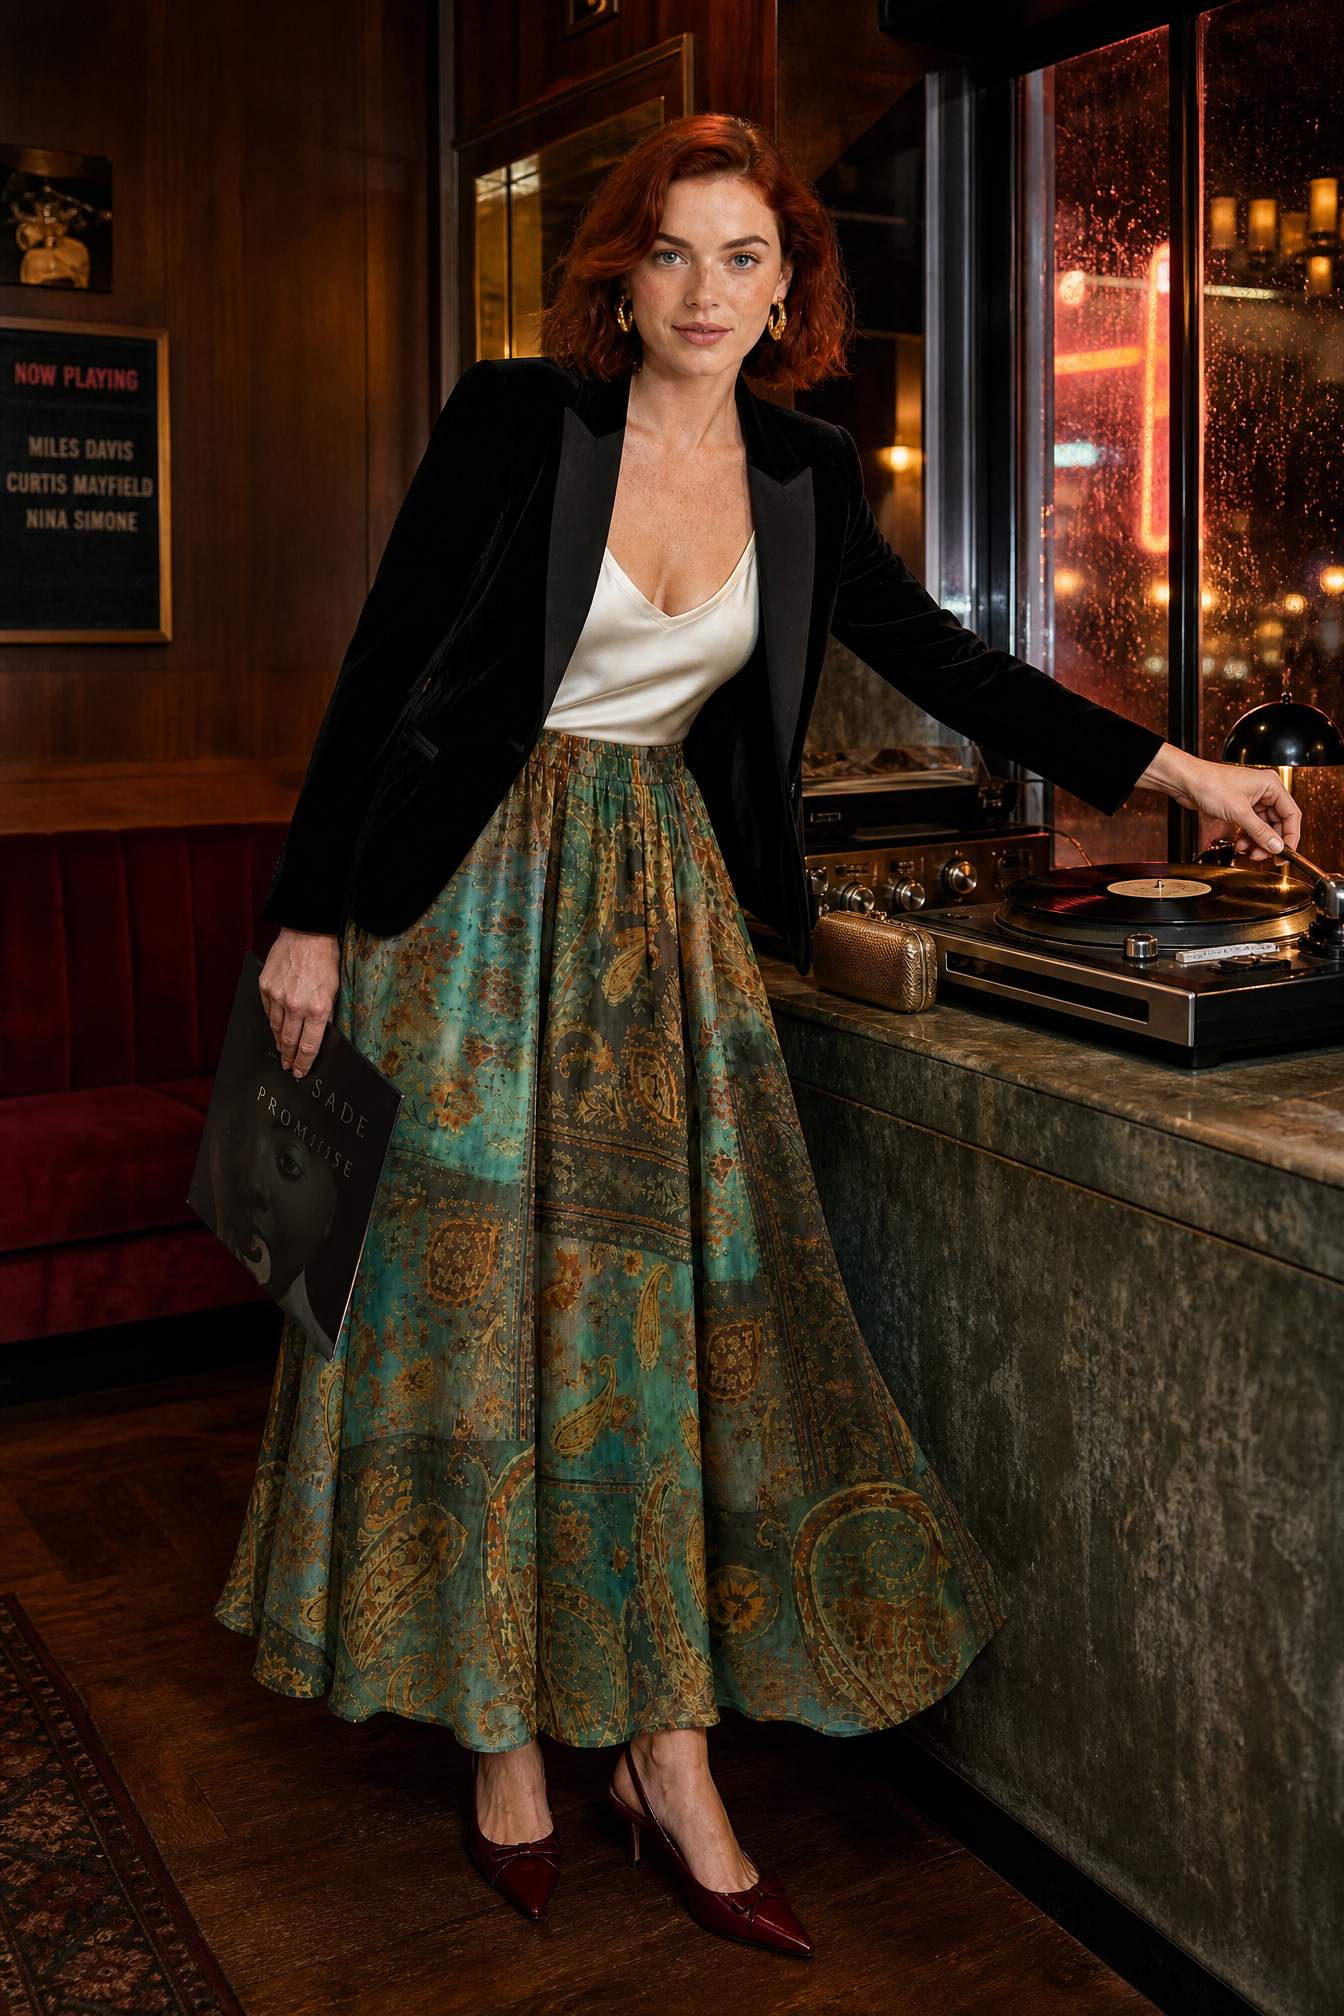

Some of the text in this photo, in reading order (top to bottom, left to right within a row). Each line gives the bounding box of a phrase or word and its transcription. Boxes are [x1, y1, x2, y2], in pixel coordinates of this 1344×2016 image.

[14, 362, 138, 391] NOW PLAYING
[28, 436, 134, 462] MILES DAVIS
[6, 471, 154, 498] CURTIS MAYFIELD
[26, 508, 138, 533] NINA SIMONE
[311, 1078, 369, 1138] SADE
